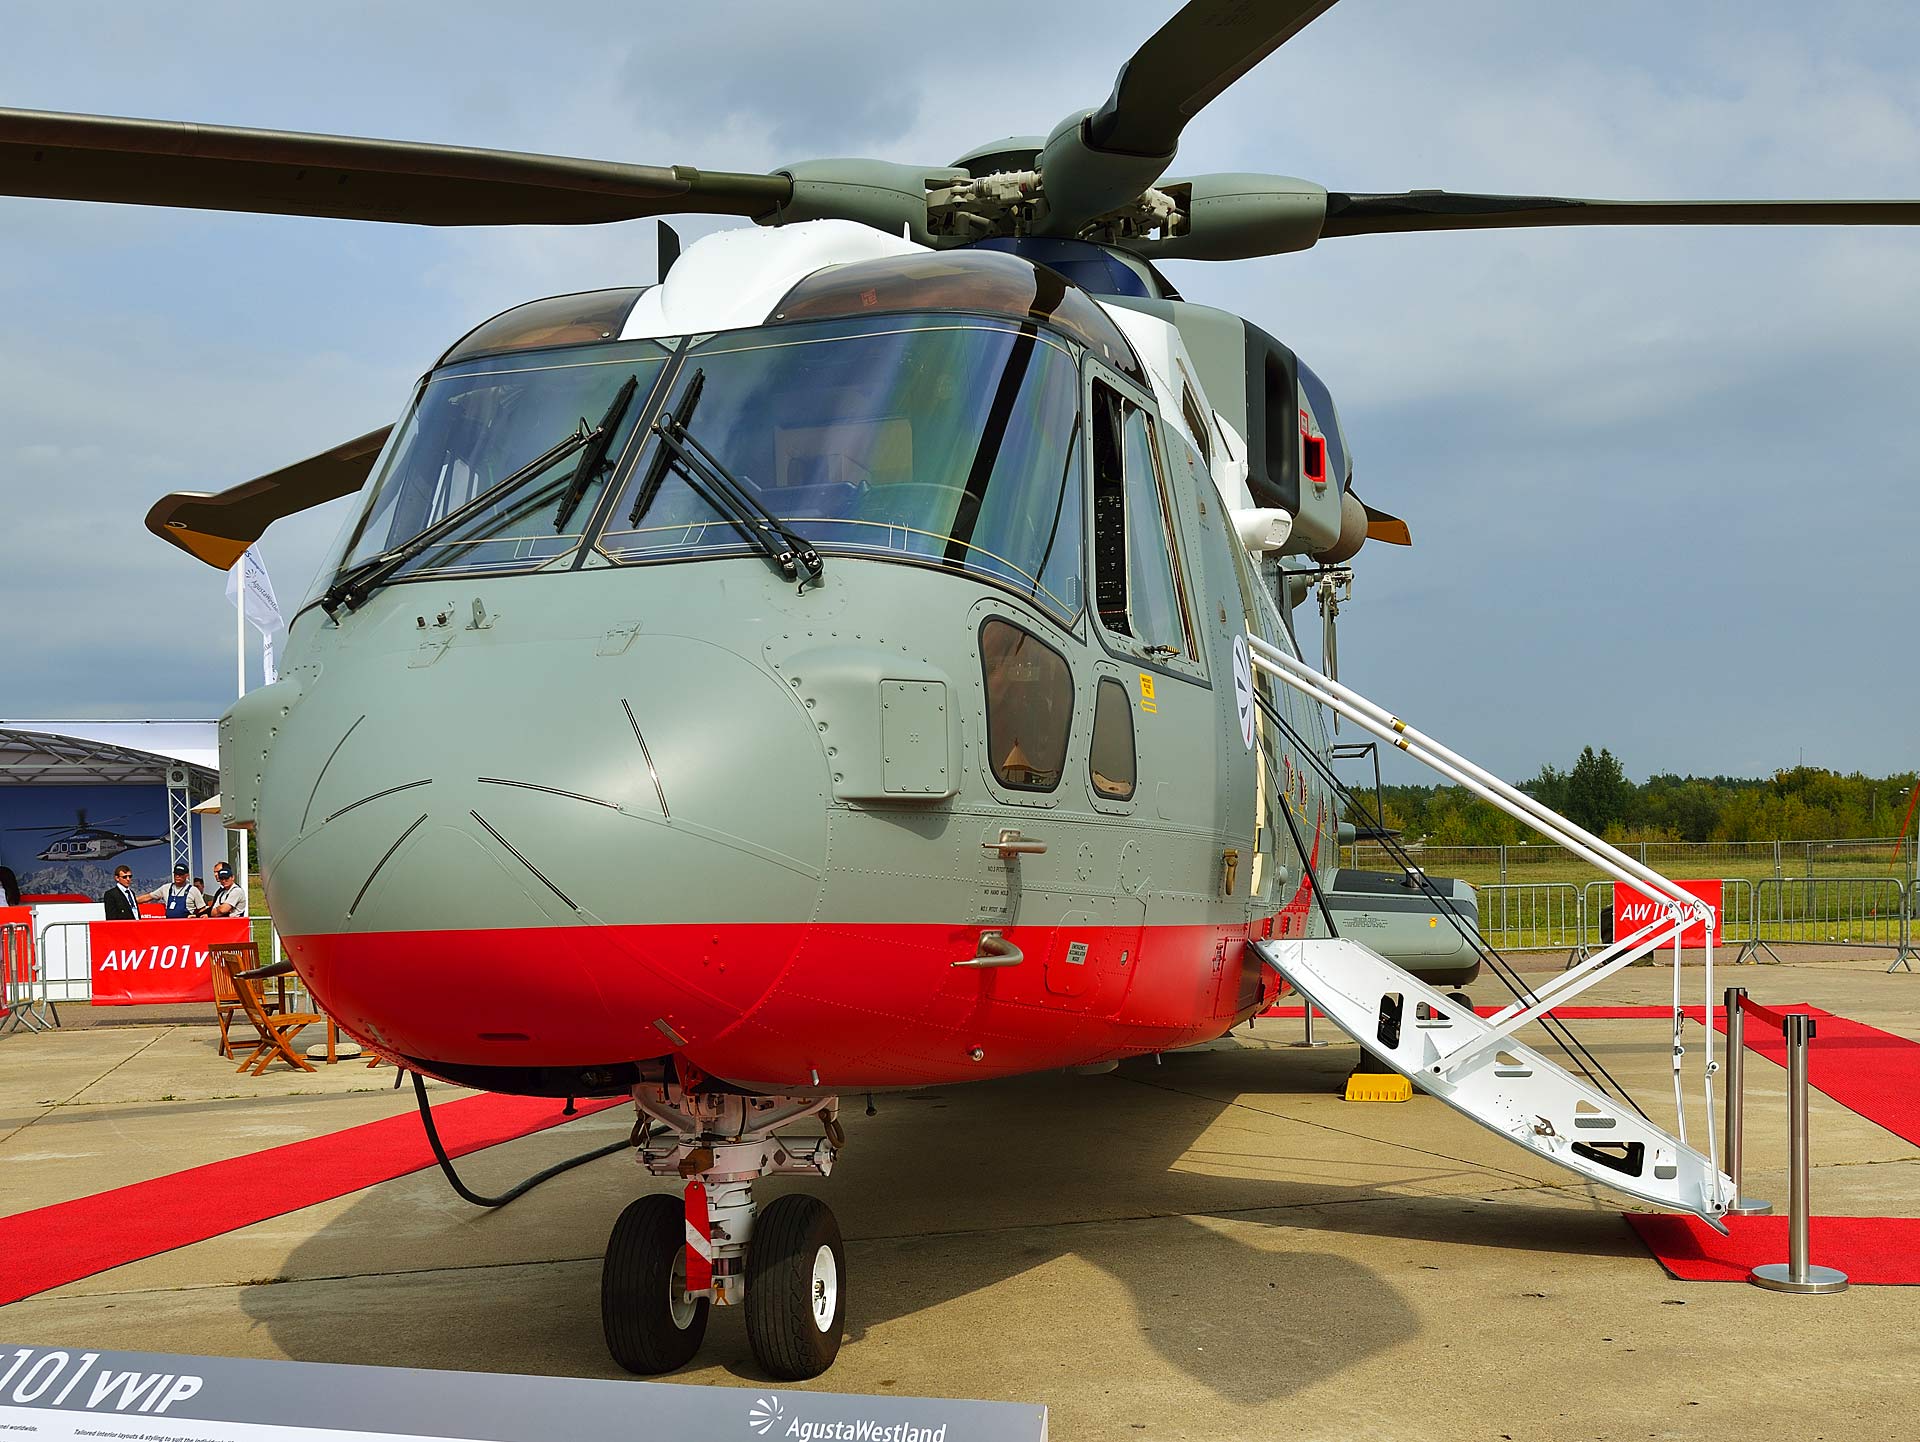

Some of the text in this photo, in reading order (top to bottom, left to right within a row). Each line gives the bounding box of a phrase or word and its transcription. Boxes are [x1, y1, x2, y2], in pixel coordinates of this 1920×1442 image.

[0, 1348, 204, 1414] 101 VVIP
[785, 1416, 947, 1442] AgustaWestland
